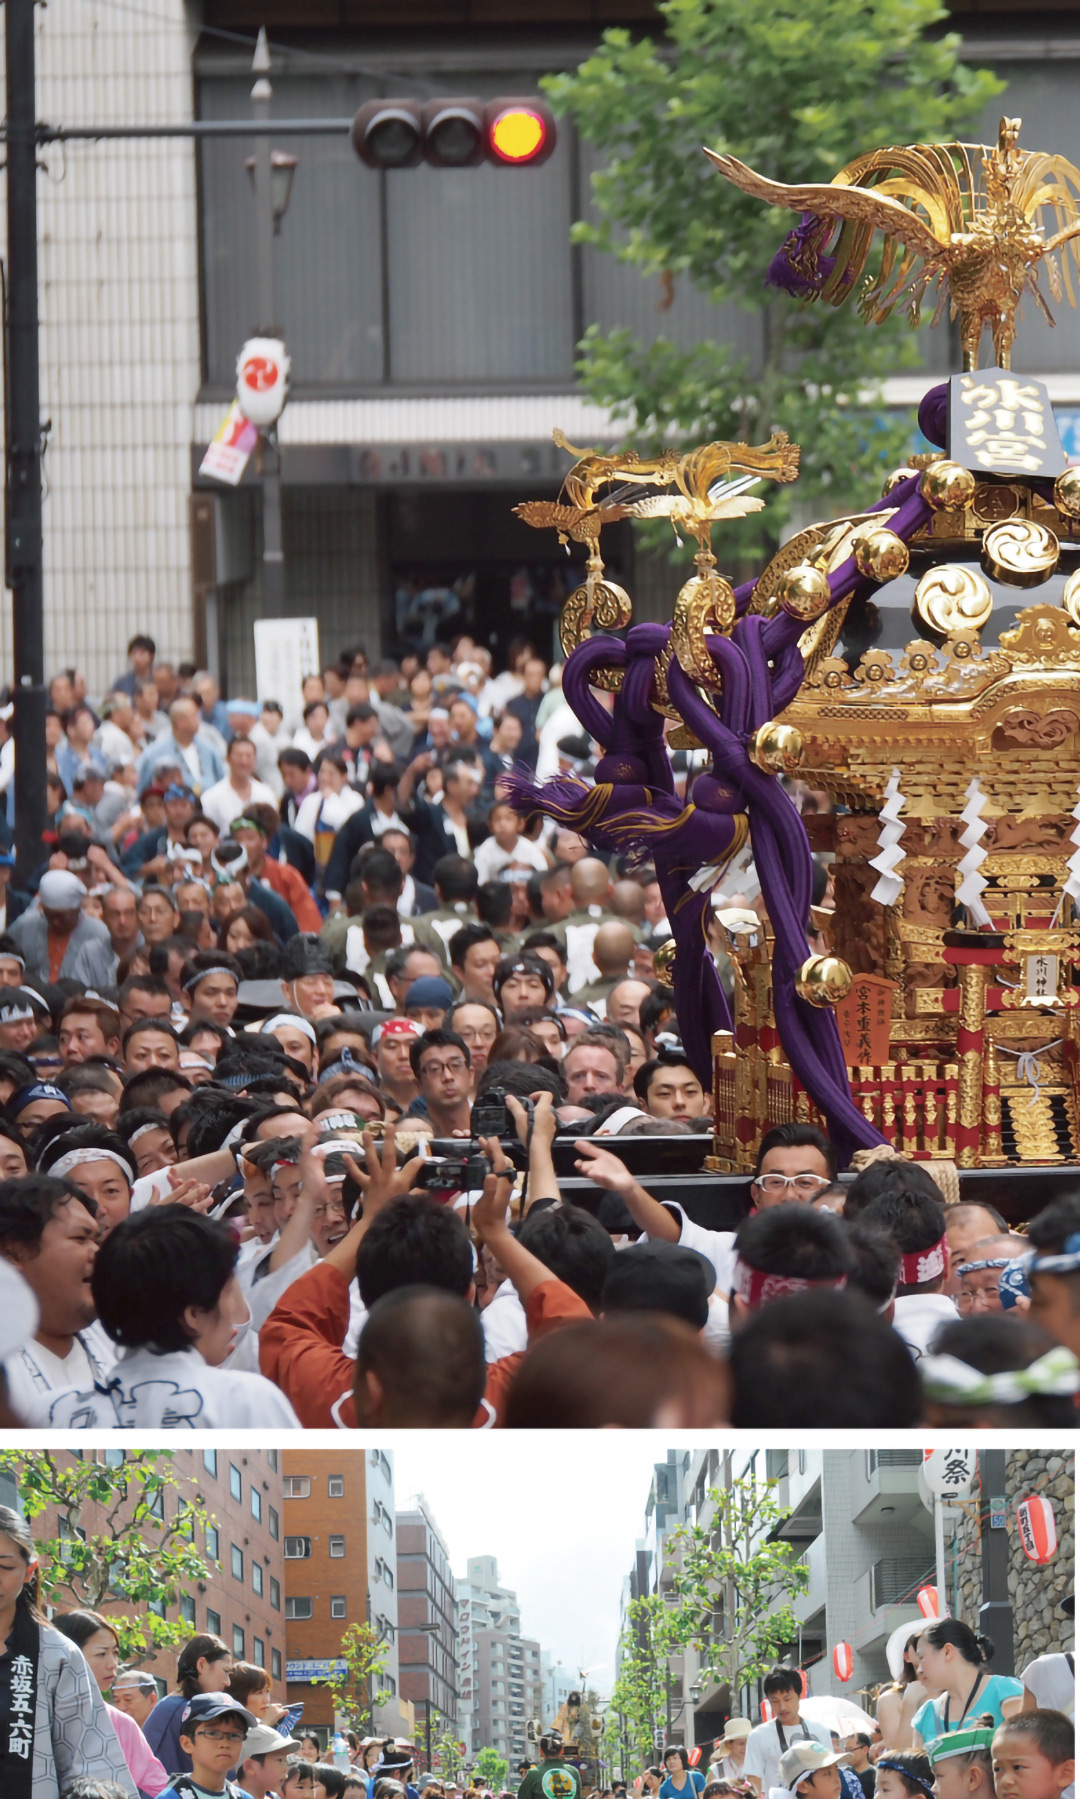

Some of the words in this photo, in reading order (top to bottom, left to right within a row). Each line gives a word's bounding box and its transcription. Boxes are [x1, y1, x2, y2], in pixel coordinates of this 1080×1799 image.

[960, 377, 1045, 471] 氷川宮
[8, 1654, 35, 1760] 赤坂五・六町
